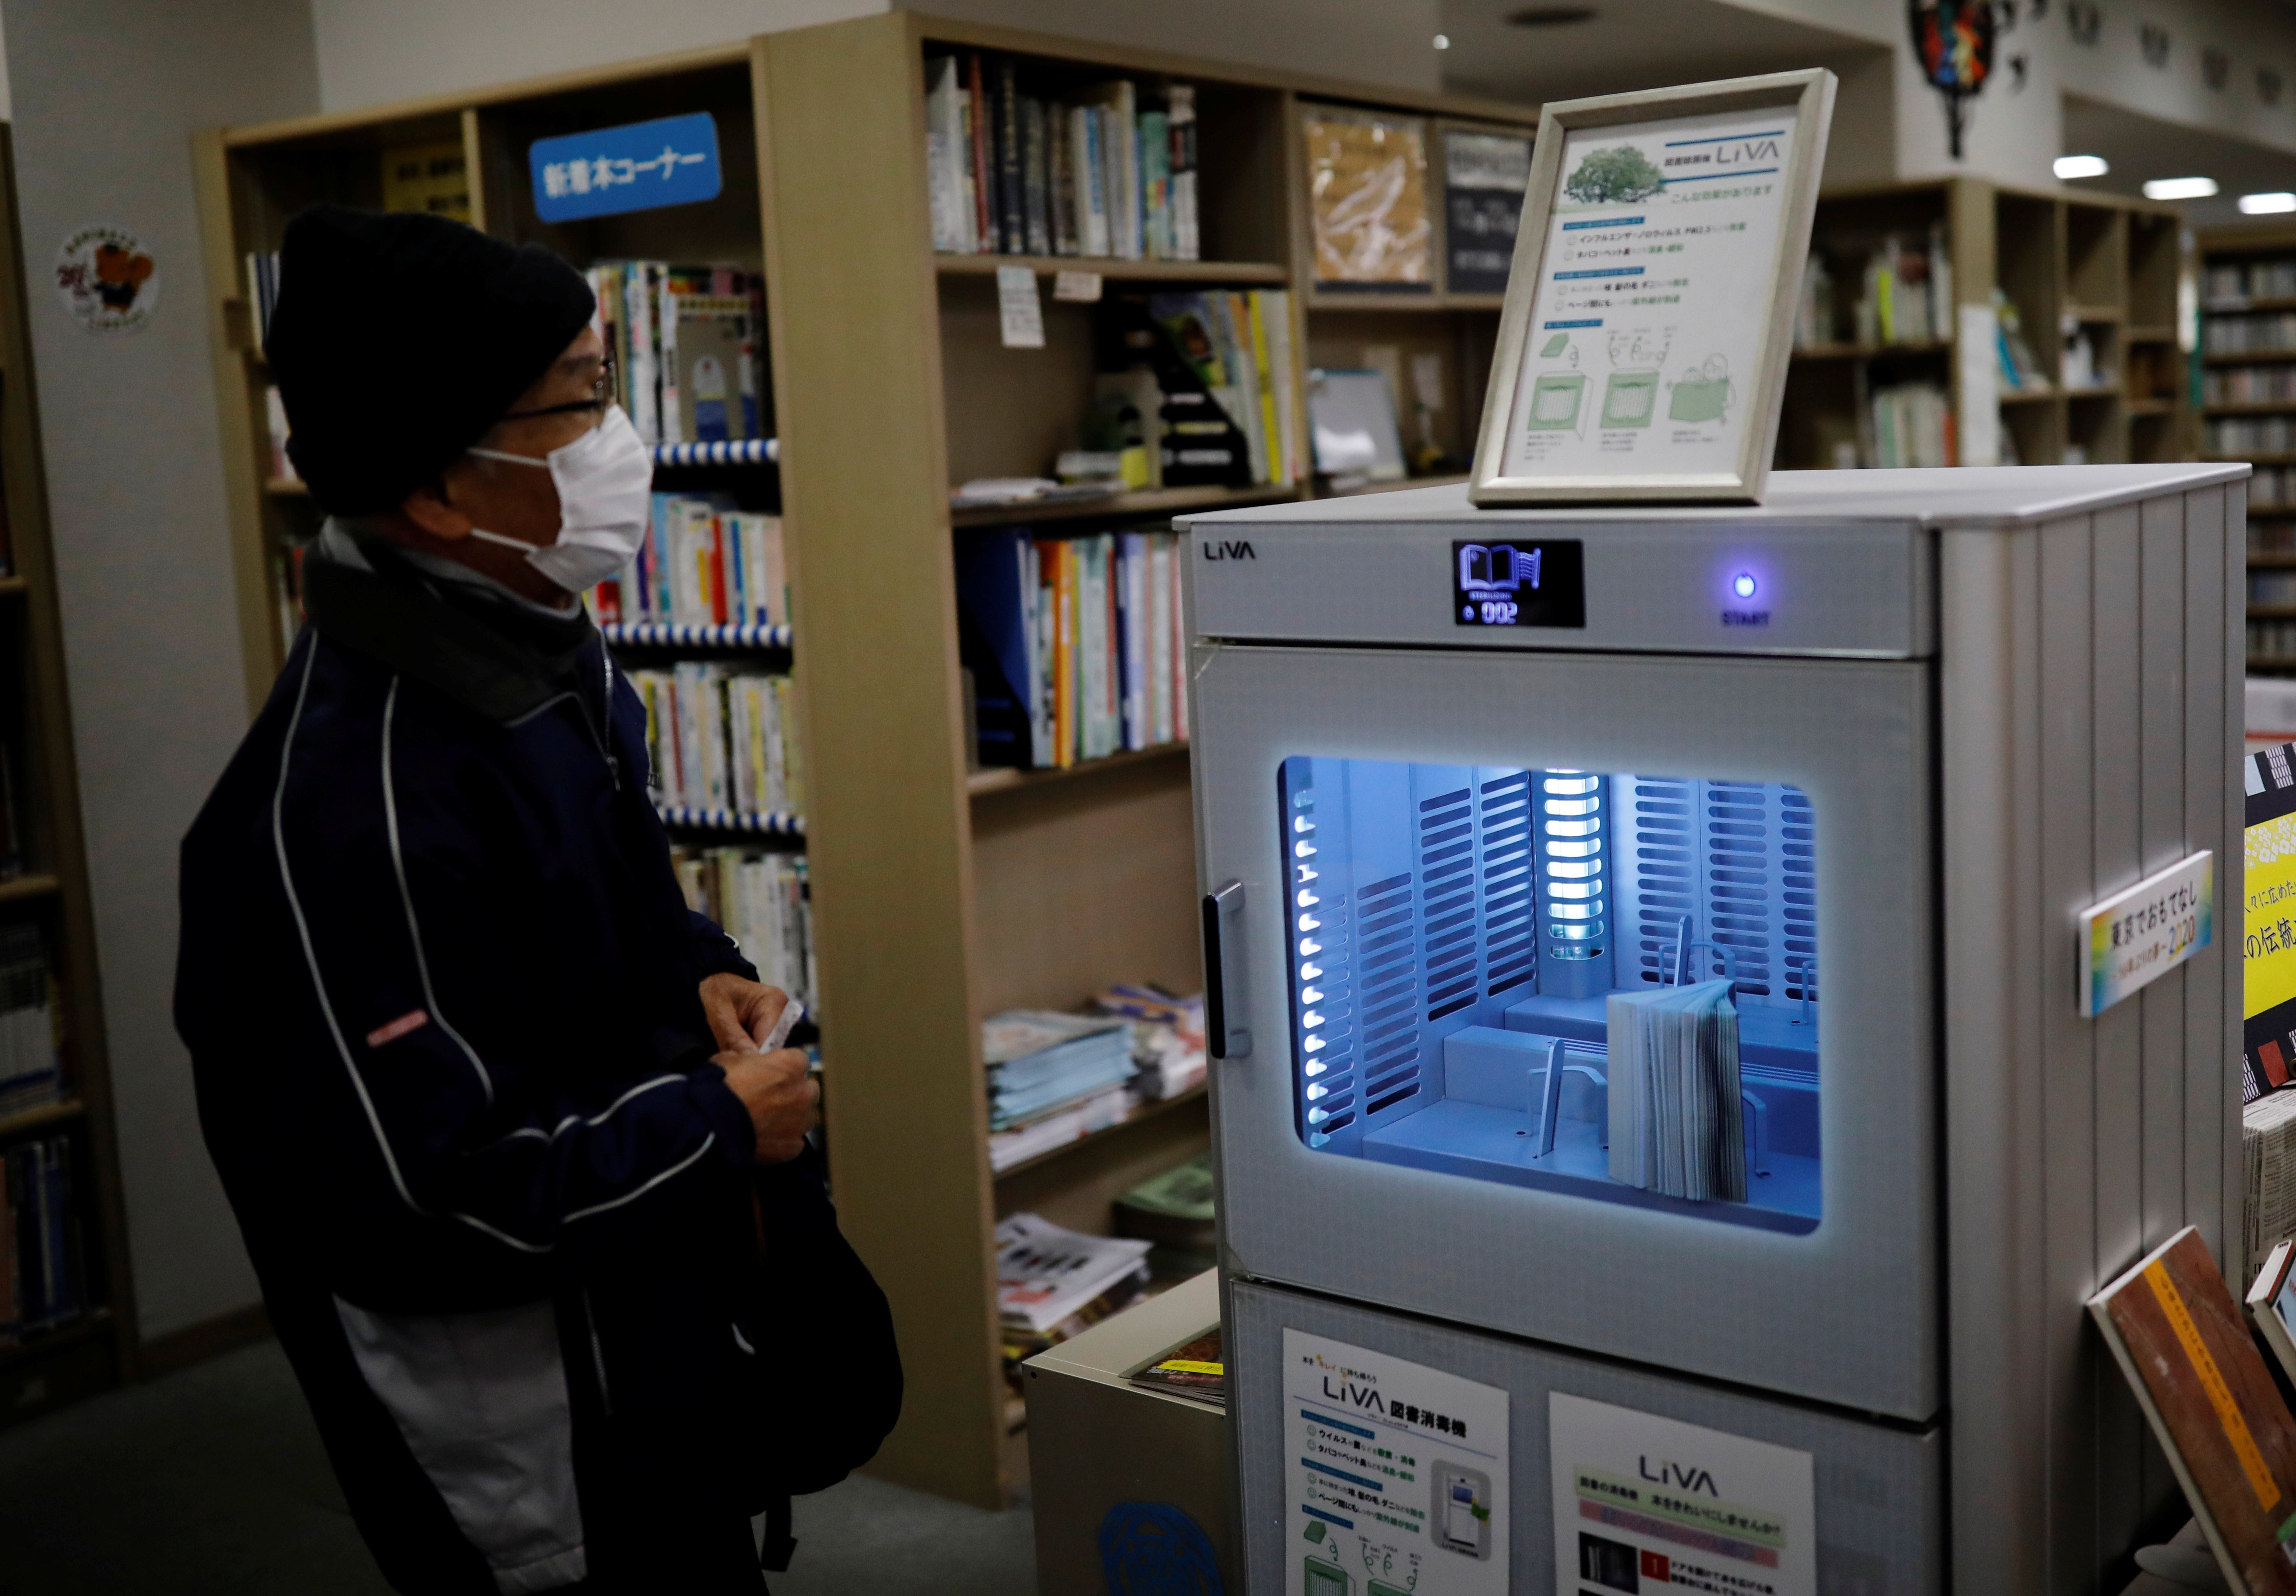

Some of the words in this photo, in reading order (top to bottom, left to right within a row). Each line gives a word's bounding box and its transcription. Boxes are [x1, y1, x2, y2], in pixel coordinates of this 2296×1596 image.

[1716, 140, 1779, 165] LiVA
[1204, 541, 1256, 560] LiVA
[1481, 602, 1518, 624] 002
[2111, 880, 2197, 951] 東京でおもてなし
[2245, 879, 2296, 913] 々に広めた
[2168, 915, 2195, 955] 2020
[2244, 917, 2296, 961] の伝統
[1324, 1376, 1385, 1413] LiVA
[1390, 1400, 1466, 1439] 図書消毒機
[1639, 1455, 1718, 1498] LiVA
